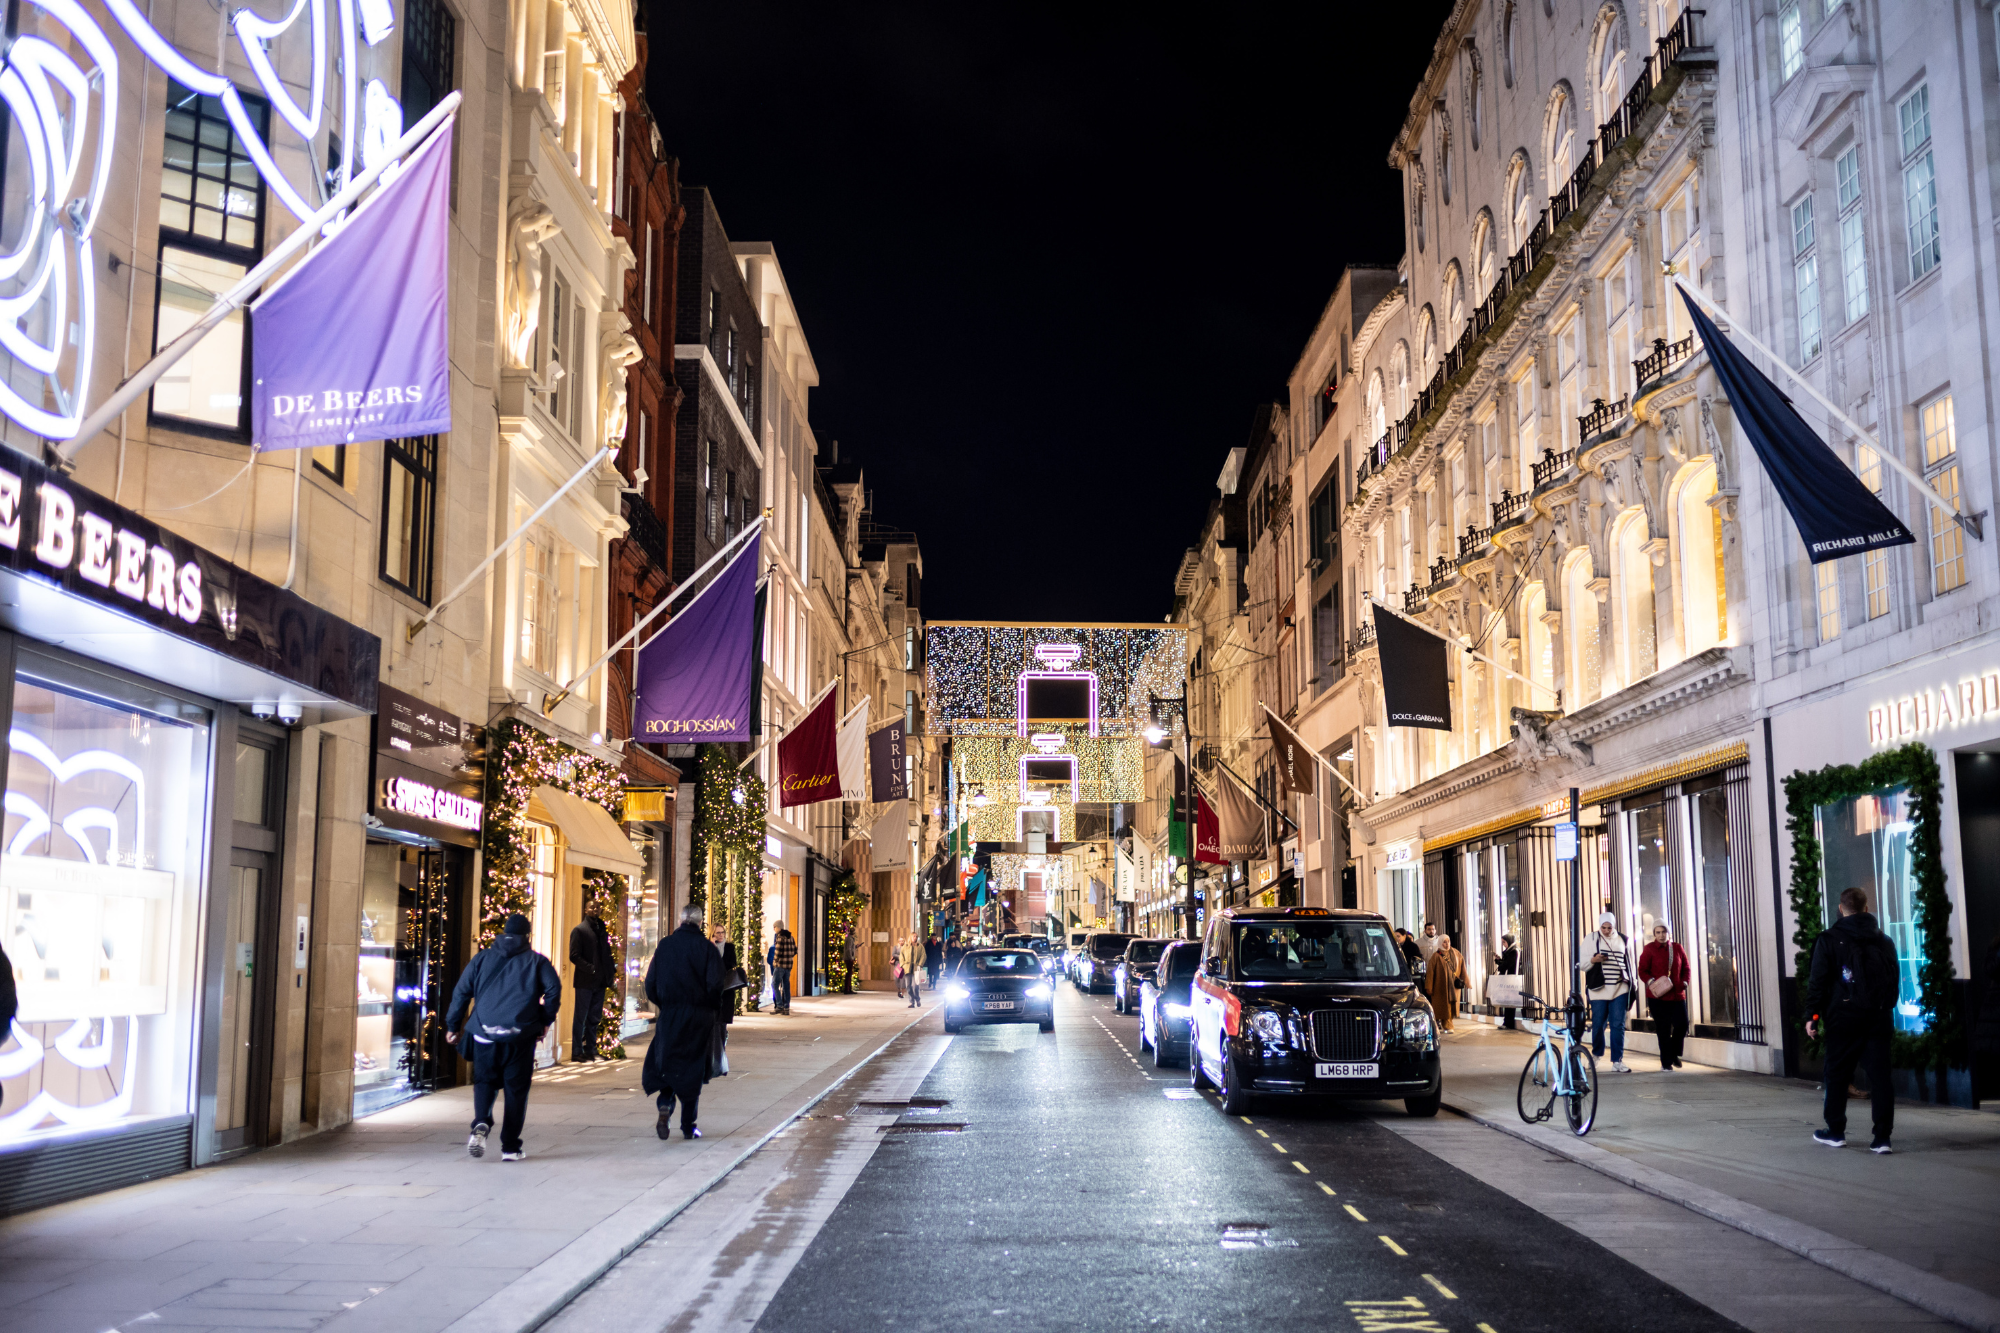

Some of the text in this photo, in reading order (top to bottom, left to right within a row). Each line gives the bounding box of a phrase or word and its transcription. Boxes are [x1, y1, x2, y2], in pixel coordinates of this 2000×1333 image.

[272, 385, 423, 417] DE BEERS
[310, 413, 384, 428] JEWELLERY
[1812, 528, 1902, 553] RICHARD MILLE
[36, 481, 202, 624] BEERS
[1868, 673, 2000, 744] RICHARD
[1415, 713, 1444, 723] GABBANA
[782, 773, 836, 791] Cartier
[891, 790, 904, 798] ART
[395, 776, 484, 832] SWISS GALLERY
[1224, 843, 1264, 855] DAMIANI
[1320, 1065, 1374, 1076] LM68 HRP
